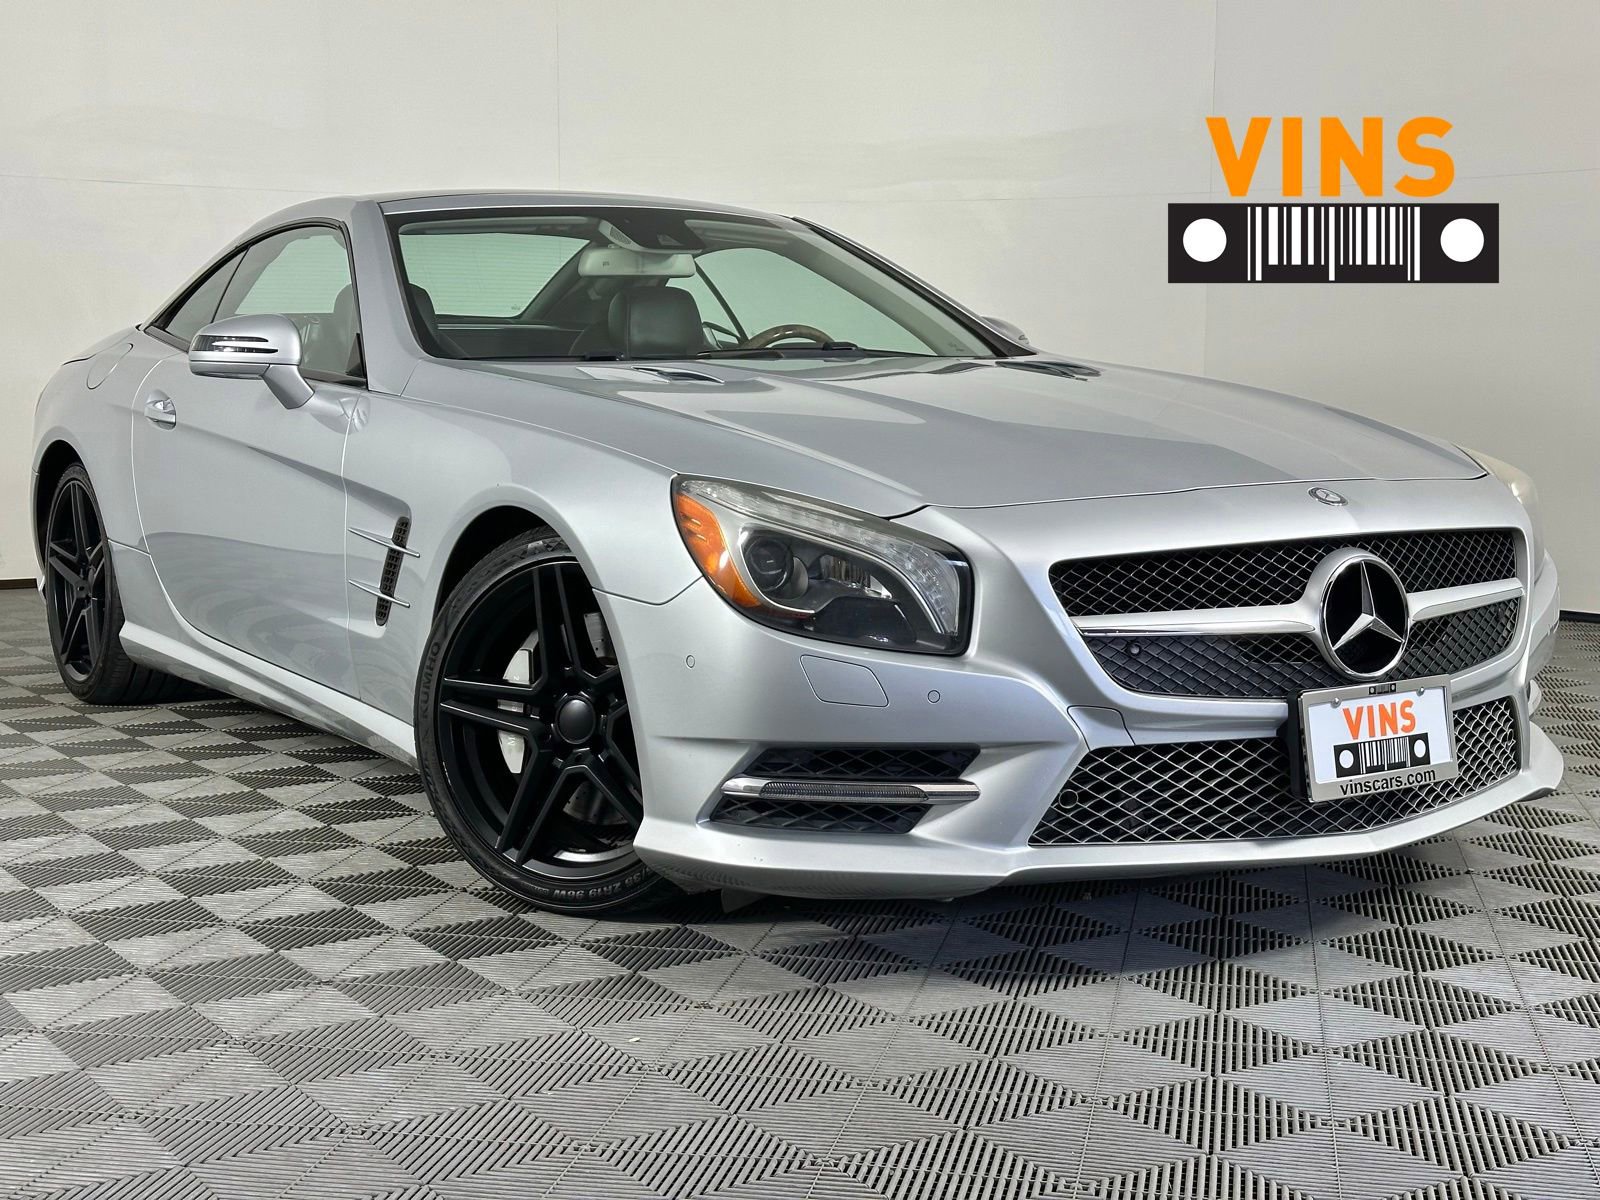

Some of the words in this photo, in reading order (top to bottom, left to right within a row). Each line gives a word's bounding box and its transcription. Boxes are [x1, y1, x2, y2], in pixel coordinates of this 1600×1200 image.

[419, 641, 441, 718] KUMHO
[1342, 699, 1416, 740] VINS
[1339, 769, 1436, 796] vinscars.com
